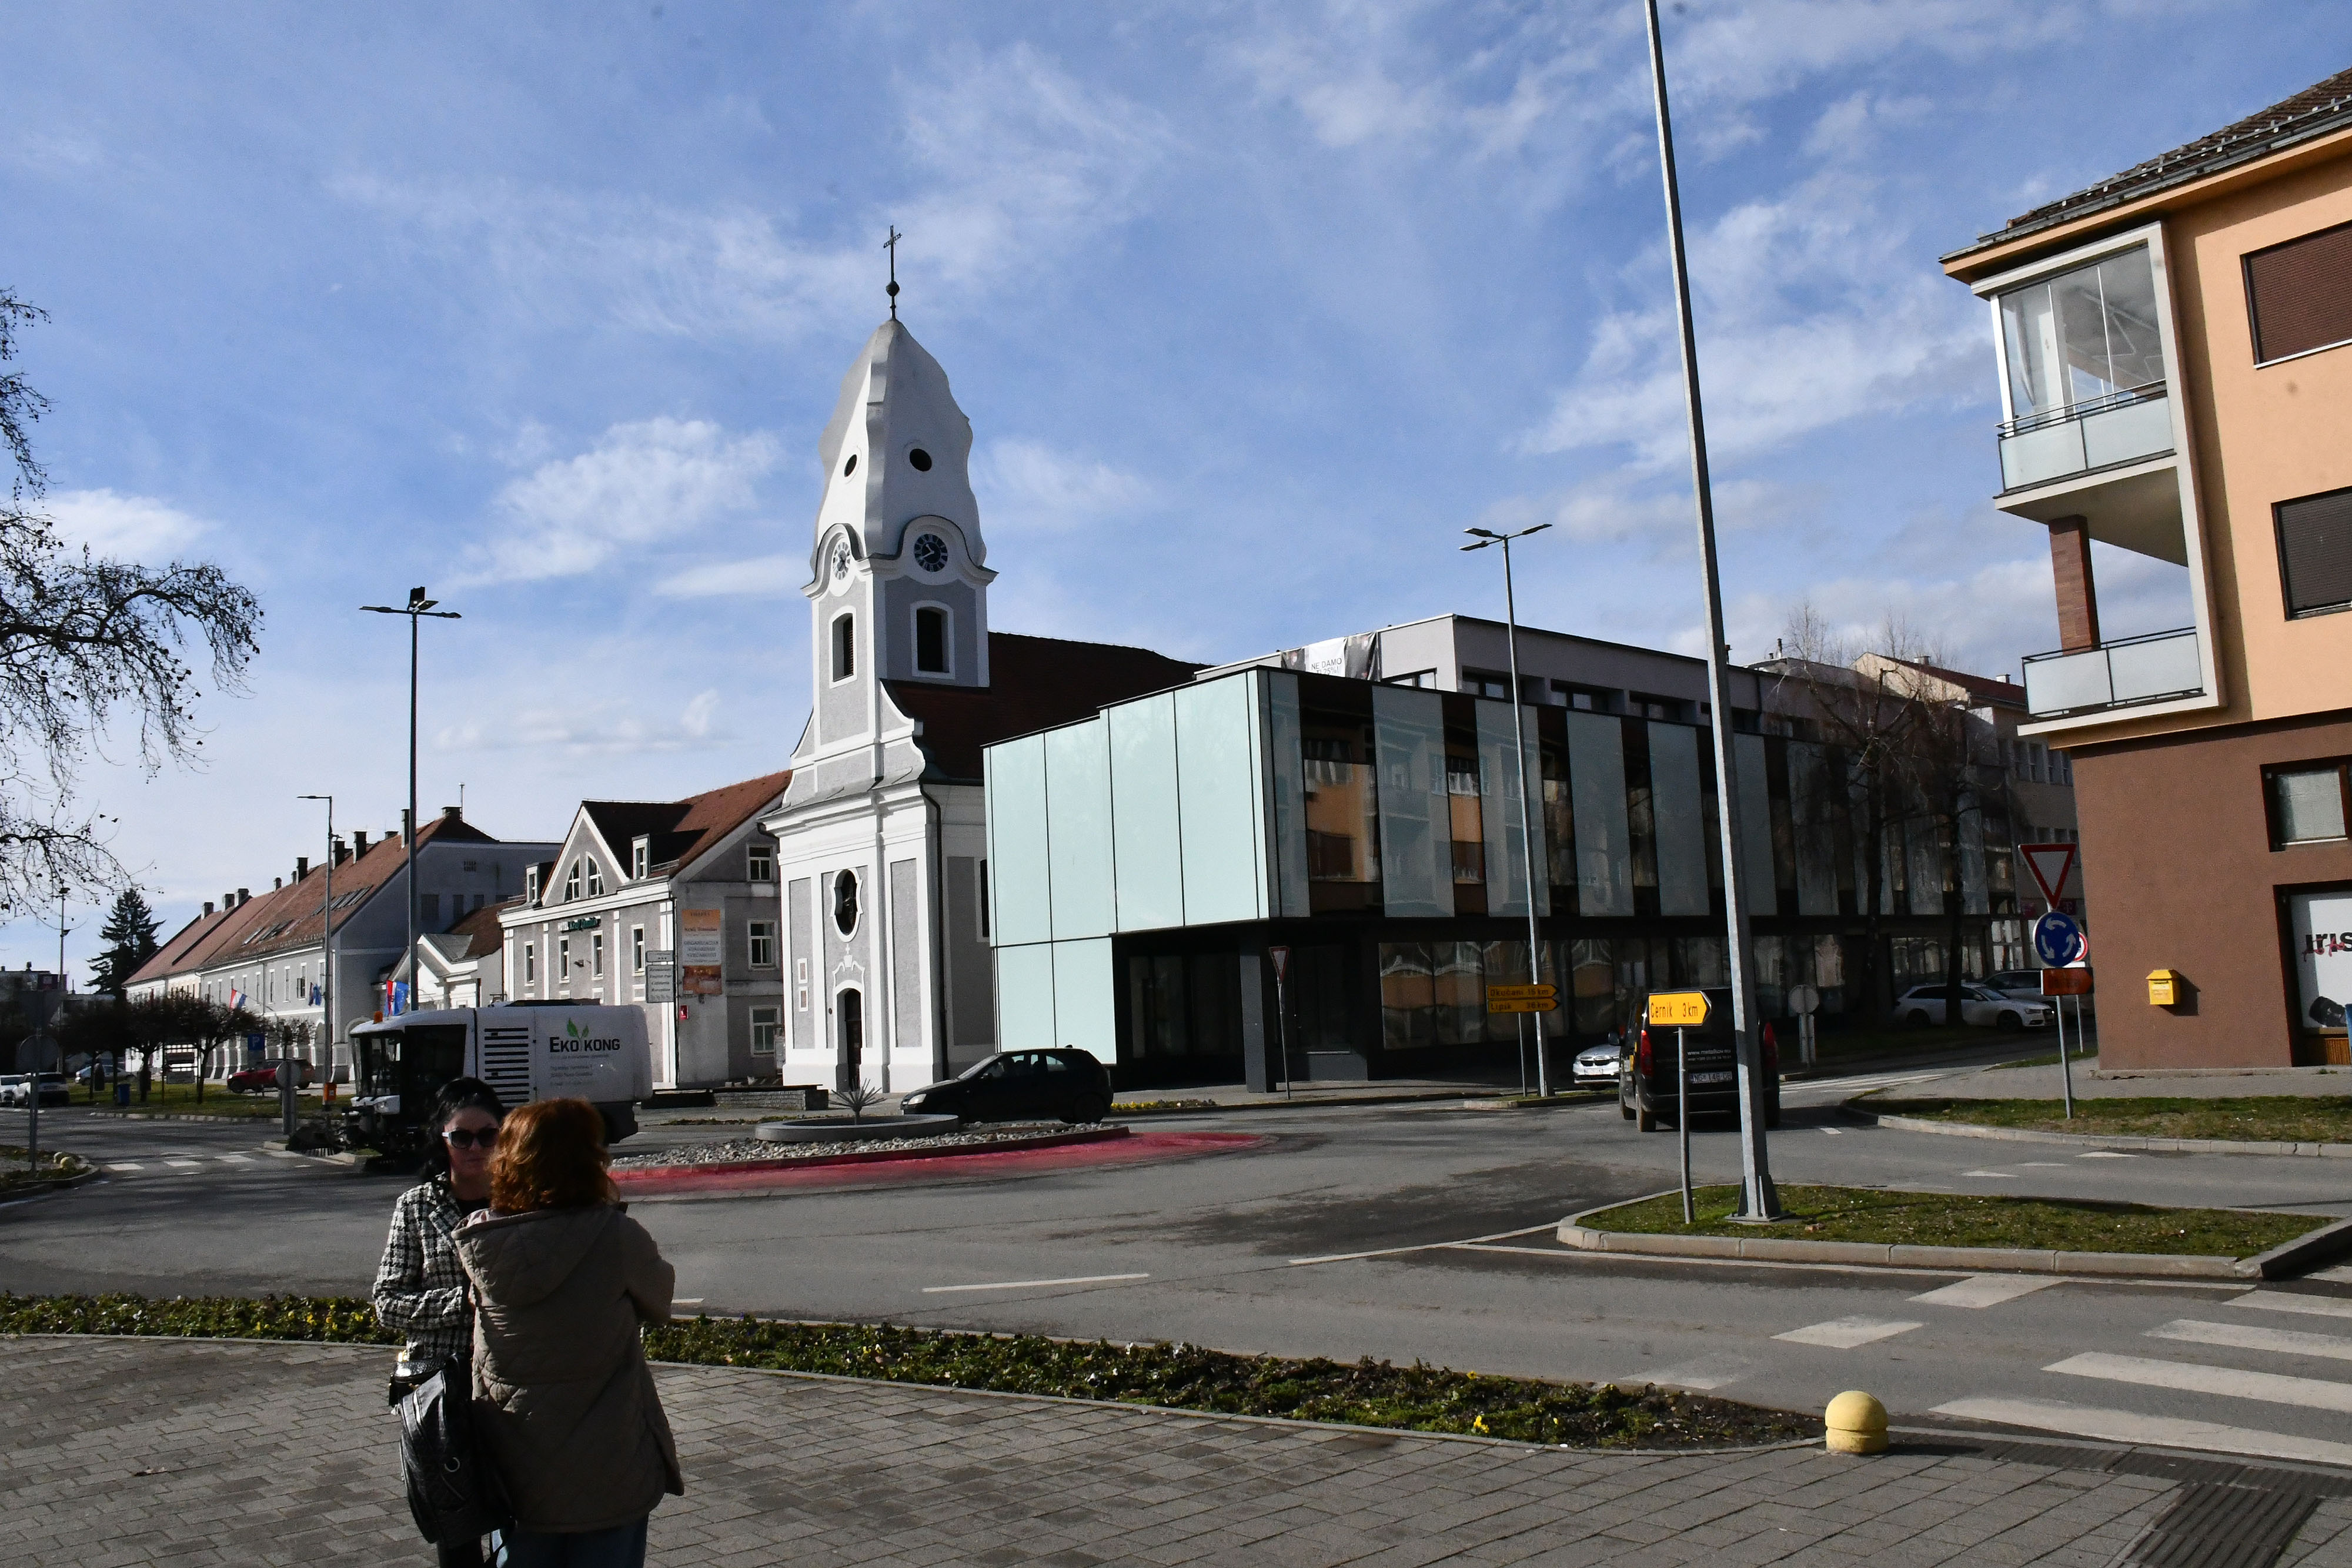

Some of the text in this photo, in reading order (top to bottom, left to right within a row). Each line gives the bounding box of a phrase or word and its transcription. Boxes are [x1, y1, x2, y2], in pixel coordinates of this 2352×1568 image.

[1321, 657, 1342, 668] DAMO
[1490, 988, 1524, 997] Okučani
[1650, 1001, 1699, 1018] Cernik 3 km
[549, 1037, 621, 1053] EKO KONG
